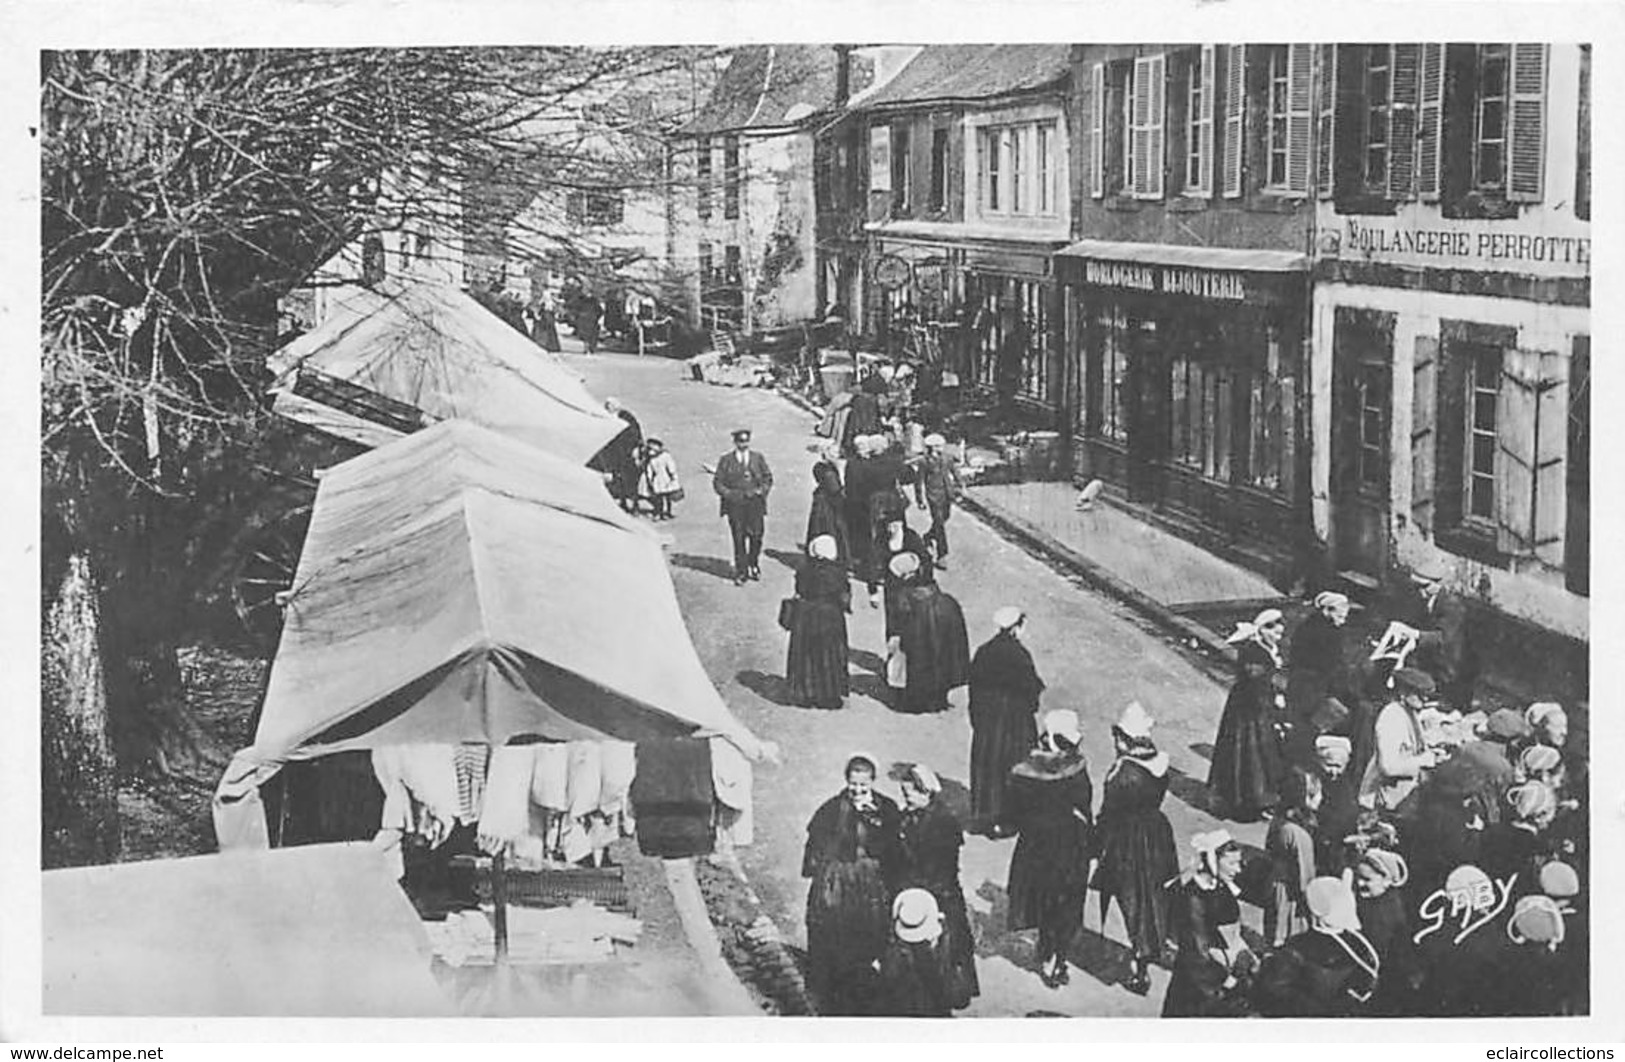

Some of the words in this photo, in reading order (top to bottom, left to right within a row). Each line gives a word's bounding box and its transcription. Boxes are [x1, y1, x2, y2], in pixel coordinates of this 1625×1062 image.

[1348, 219, 1470, 256] BOULANGERIE
[1477, 233, 1591, 264] PERROTTE
[1086, 261, 1155, 290] HORLOGERIE
[1163, 269, 1245, 300] BIJOUTERIE
